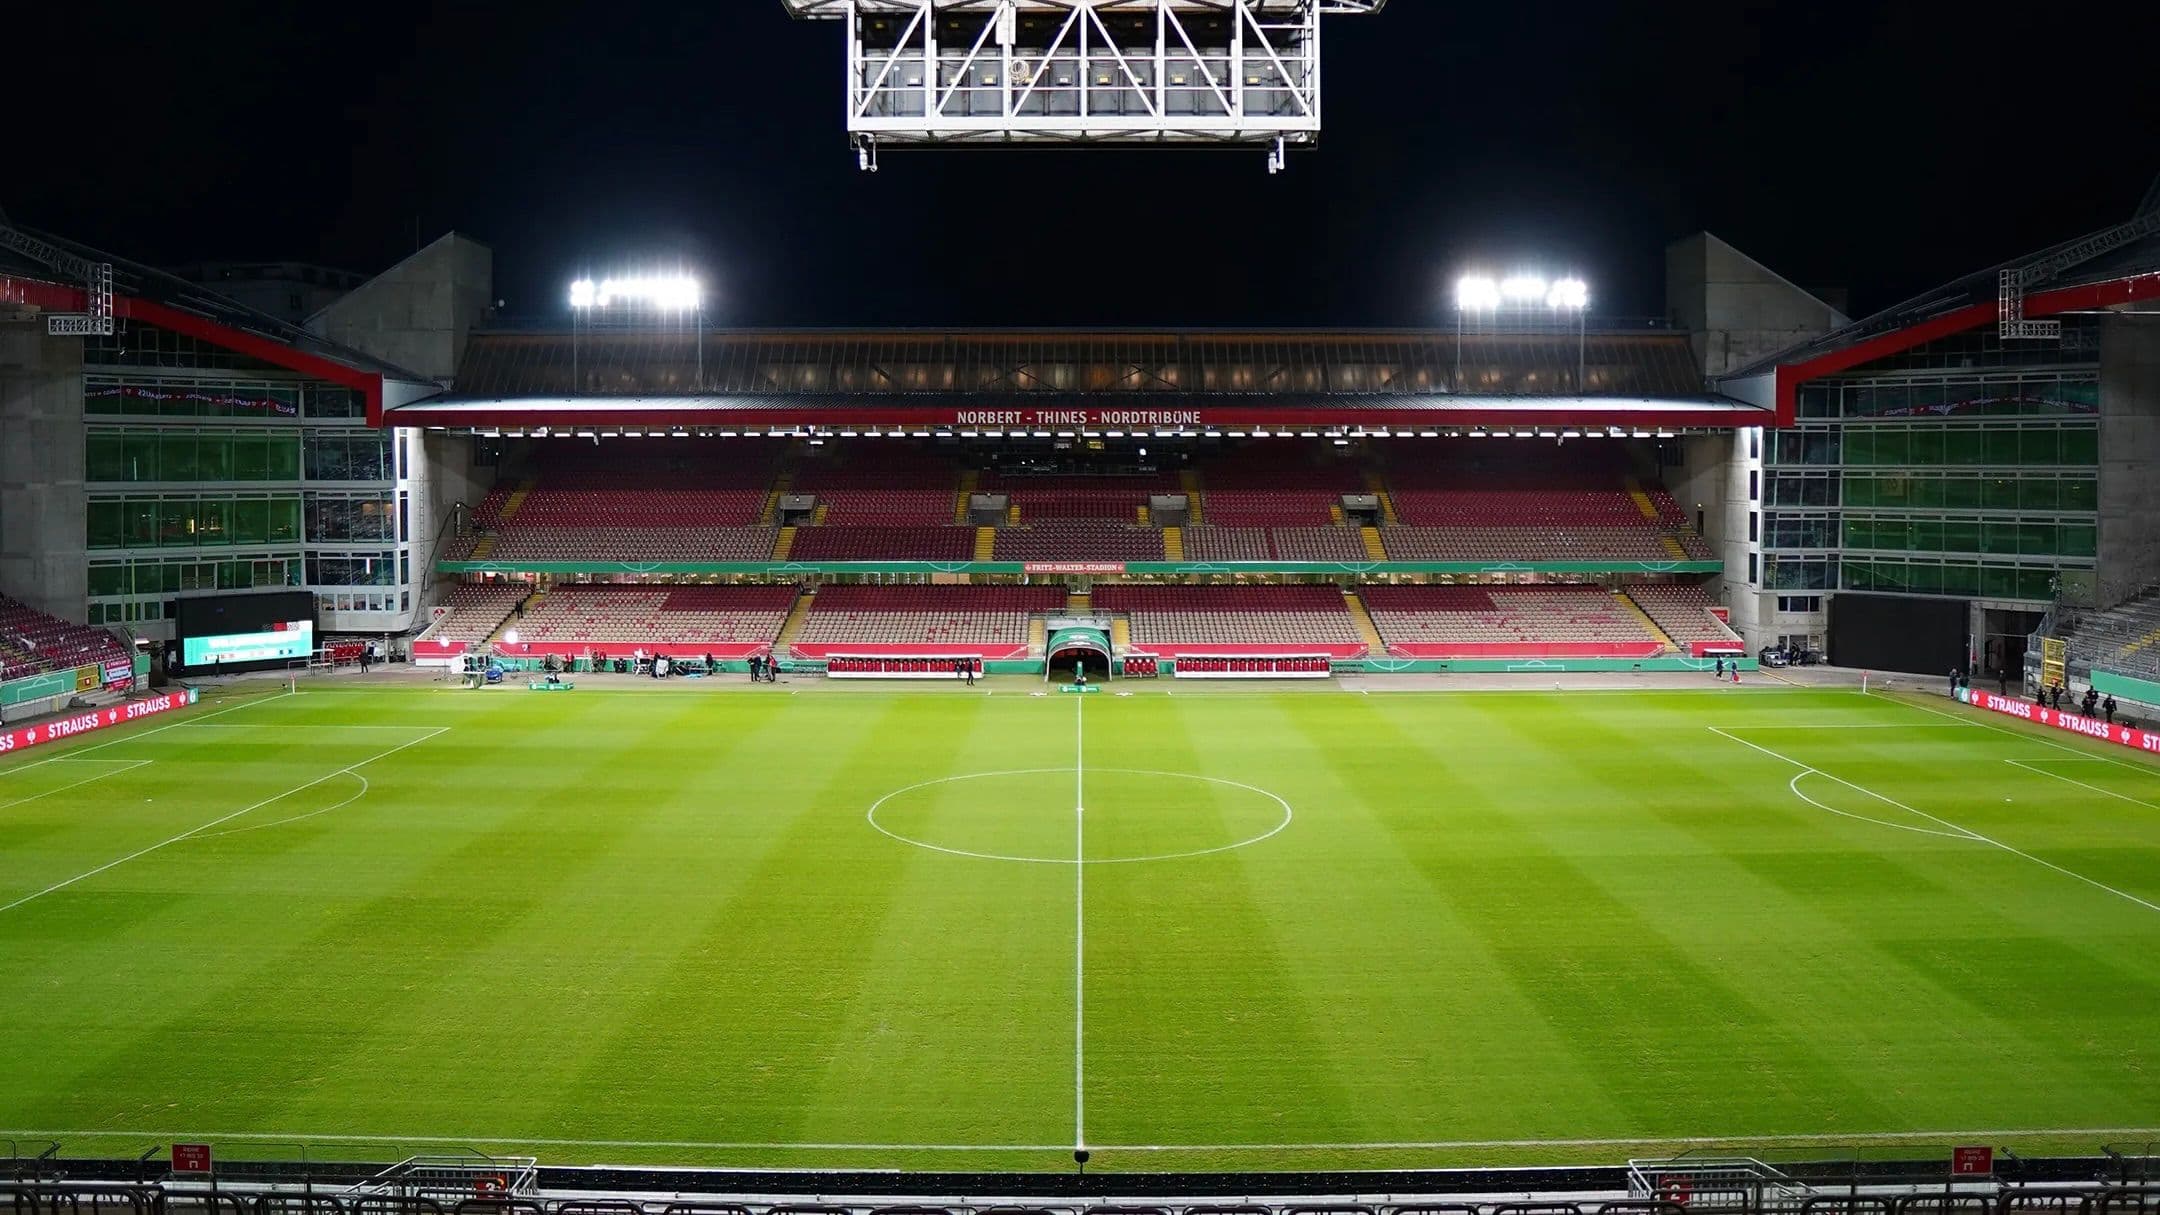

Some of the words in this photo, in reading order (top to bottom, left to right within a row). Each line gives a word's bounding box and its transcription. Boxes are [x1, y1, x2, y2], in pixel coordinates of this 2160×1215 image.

[957, 411, 1022, 424] NORBERT
[1036, 411, 1087, 424] THINES
[1101, 410, 1201, 424] NORDTRIBÜNE
[127, 695, 170, 718] STRAUSS
[1987, 695, 2031, 718] STRAUSS
[49, 713, 99, 738] STRAUSS
[2058, 713, 2109, 738] STRAUSS
[1670, 1184, 1680, 1200] 2
